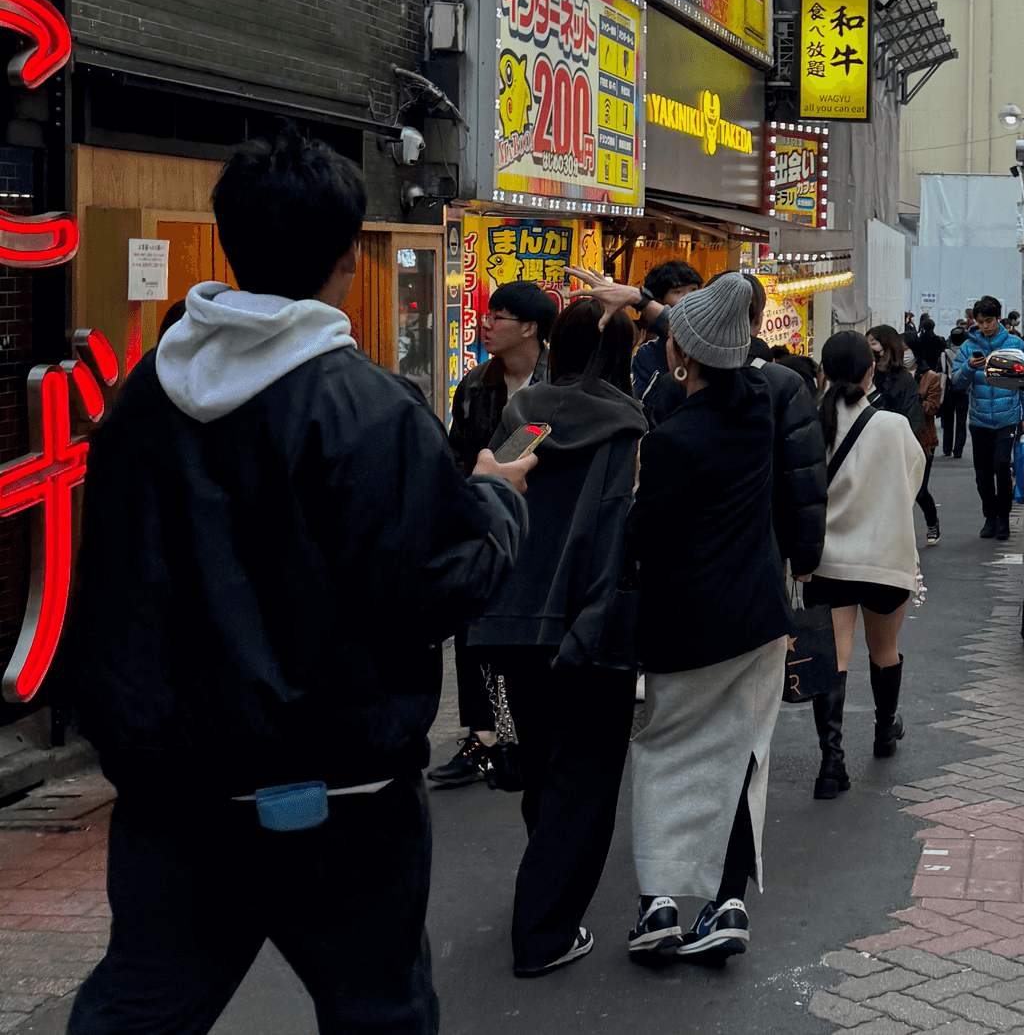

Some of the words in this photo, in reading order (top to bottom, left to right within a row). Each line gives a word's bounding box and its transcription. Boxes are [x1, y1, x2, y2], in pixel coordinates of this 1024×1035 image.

[806, 2, 827, 78] 食べ放題
[830, 5, 866, 77] 和牛
[533, 59, 591, 159] 200
[804, 104, 814, 112] all
[819, 95, 851, 103] WAGYU
[648, 93, 704, 138] YAKINIKU
[719, 126, 753, 155] TAKEDA
[774, 149, 815, 186] 出会い
[490, 227, 569, 255] まんが
